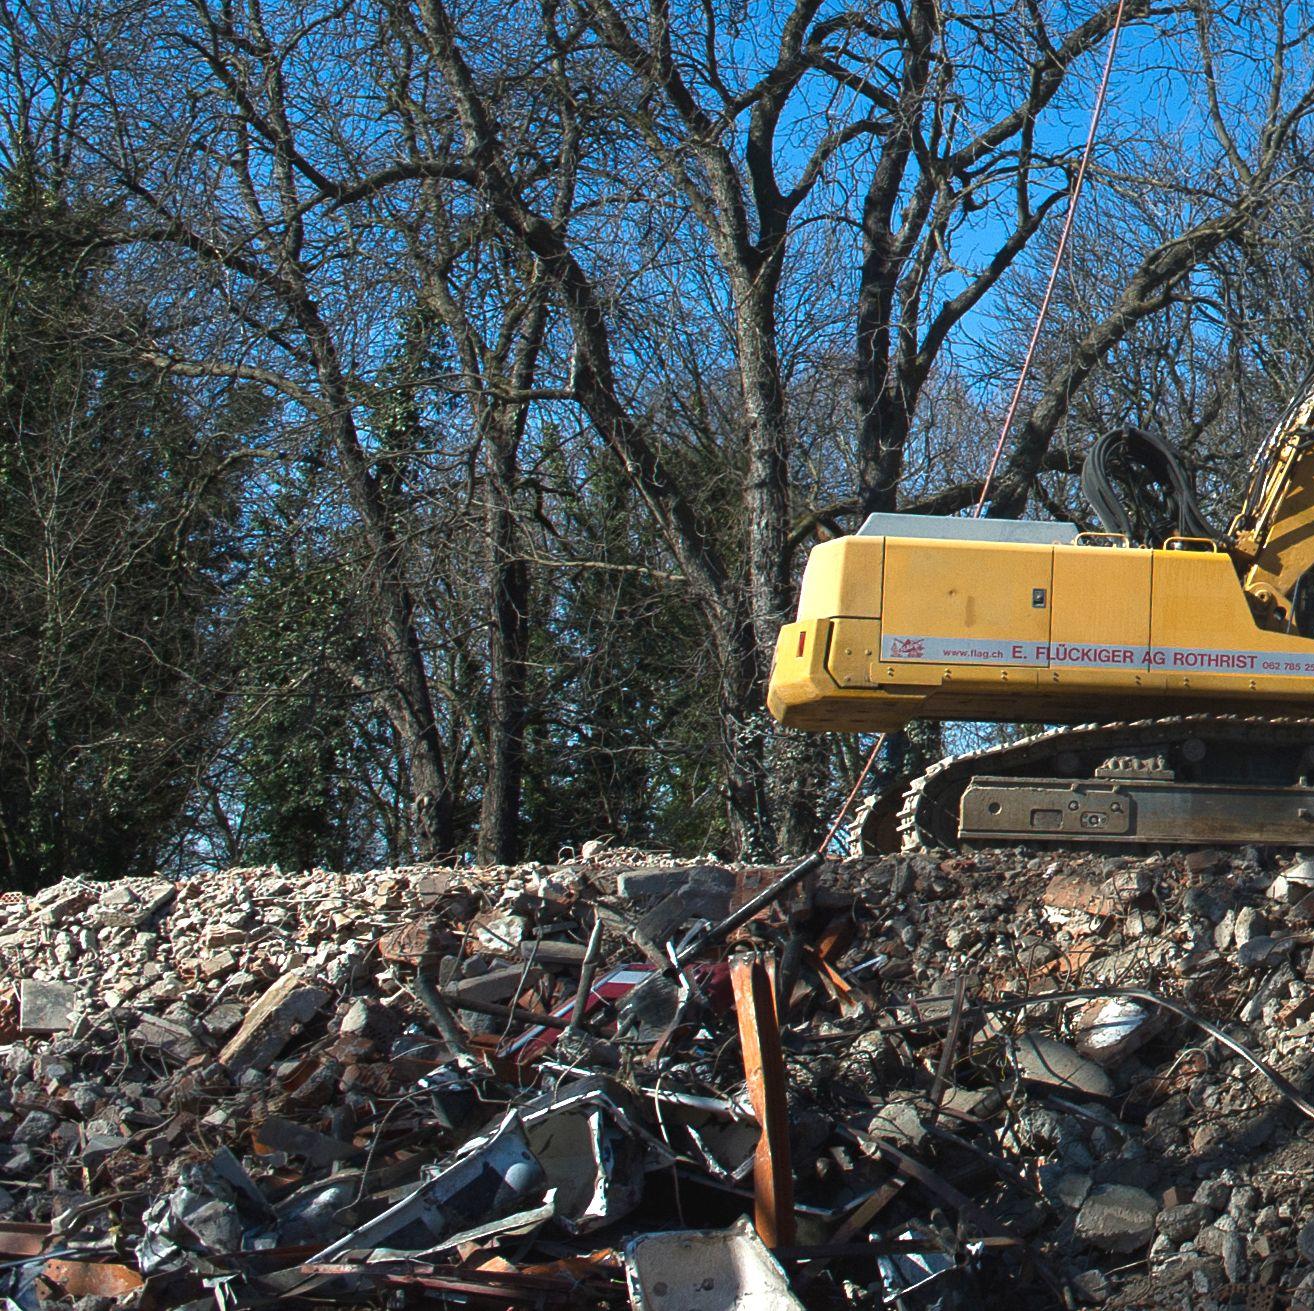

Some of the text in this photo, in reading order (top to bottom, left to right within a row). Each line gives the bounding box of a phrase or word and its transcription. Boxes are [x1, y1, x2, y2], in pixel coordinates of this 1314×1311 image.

[942, 648, 1004, 660] www.flag.ch
[1012, 645, 1027, 659] E.
[1035, 643, 1134, 663] FLÜCKIGER
[1141, 650, 1165, 665] AG
[1173, 652, 1257, 669] ROTHRIST
[1262, 661, 1280, 671] 062
[1284, 663, 1301, 671] 785
